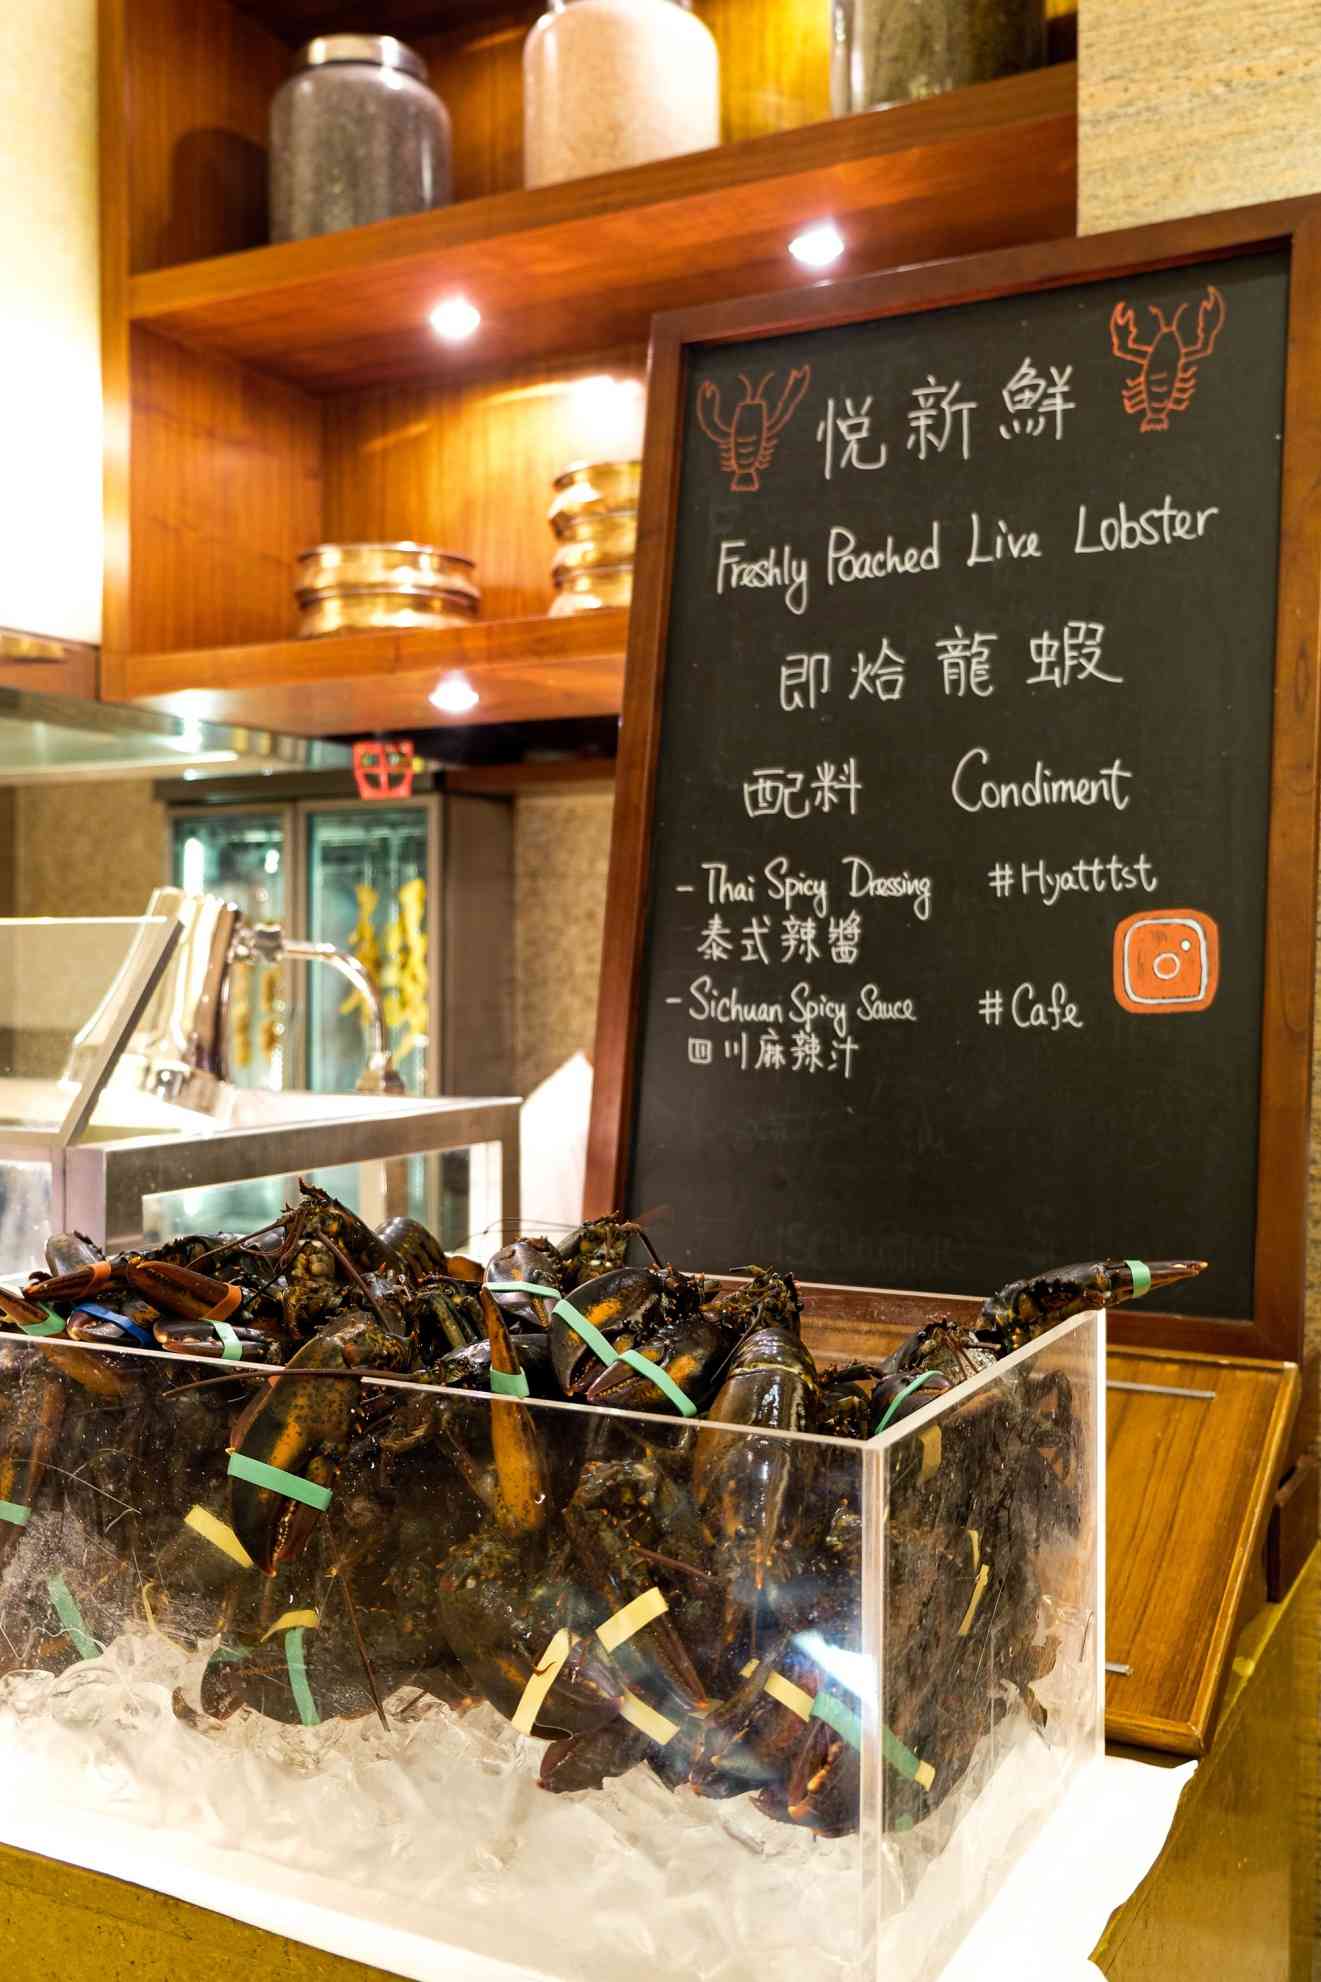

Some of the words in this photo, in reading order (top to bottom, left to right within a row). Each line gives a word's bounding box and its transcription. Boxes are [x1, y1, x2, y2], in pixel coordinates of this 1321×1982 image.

[717, 540, 808, 615] Freshly
[827, 521, 940, 586] Poached
[966, 513, 1042, 567] Live
[1074, 495, 1219, 554] Lobster
[743, 757, 862, 819] 配料
[951, 748, 1132, 812] Condiment
[701, 863, 755, 905] Thai
[762, 856, 828, 919] Spicy
[839, 856, 932, 921] Dressing
[697, 909, 862, 965] 泰式辣醬
[688, 975, 784, 1023] Sichuan
[788, 982, 847, 1037] Spicy
[856, 983, 917, 1021] Sauce
[687, 1028, 859, 1079] 四川麻辣汁
